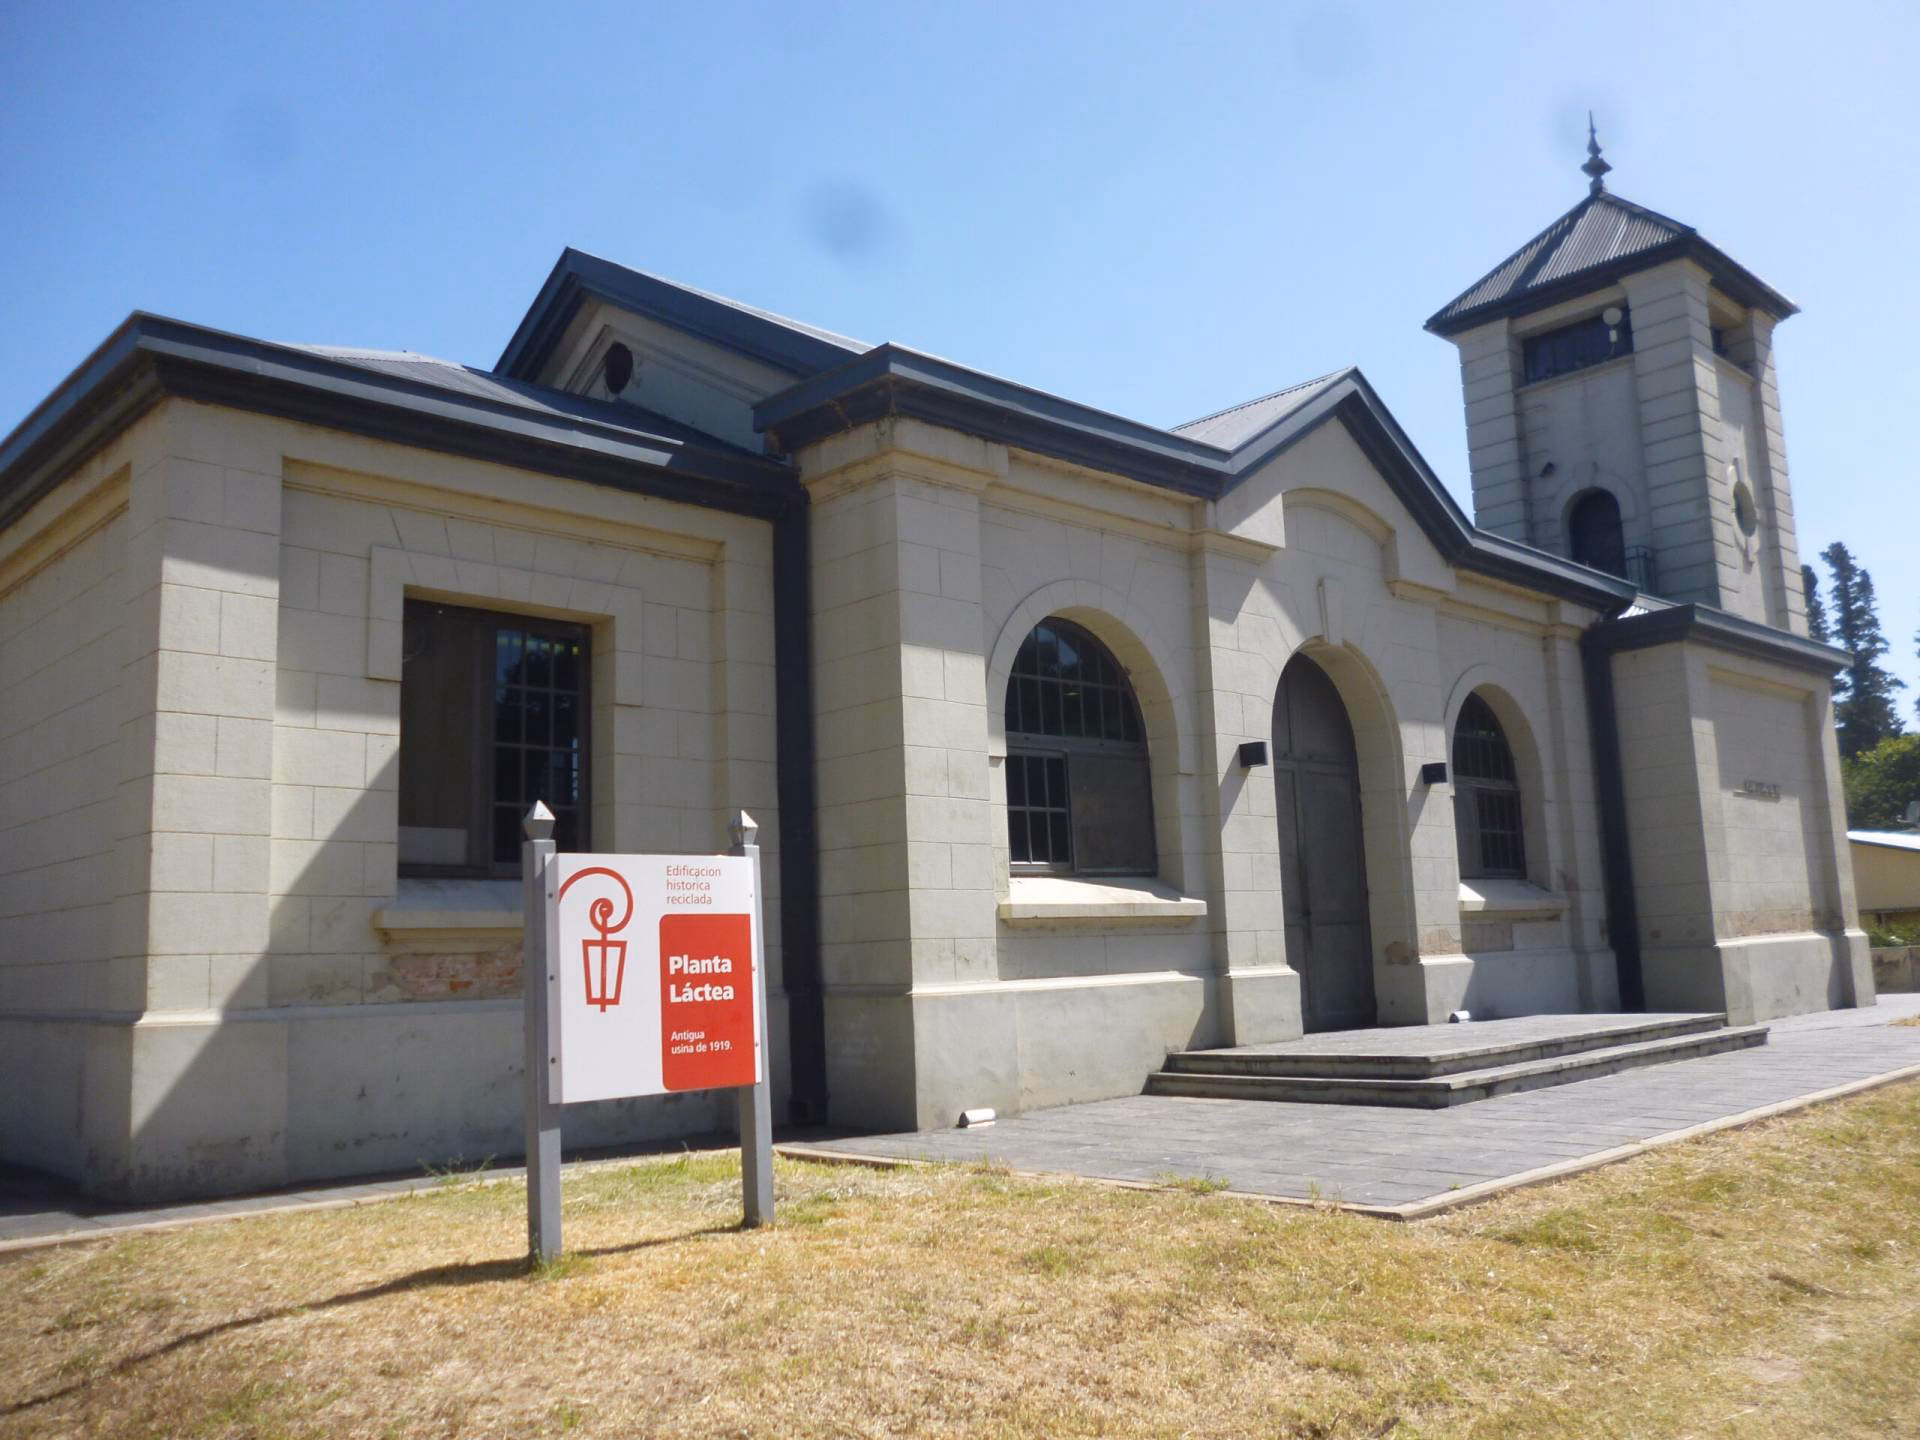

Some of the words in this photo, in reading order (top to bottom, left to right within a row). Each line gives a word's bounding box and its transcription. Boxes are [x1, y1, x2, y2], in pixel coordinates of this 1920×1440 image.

[666, 894, 712, 905] reciclada
[669, 954, 732, 975] Planta
[670, 982, 734, 1003] Láctea
[671, 1030, 705, 1043] Antigua
[671, 1045, 694, 1054] usina
[696, 1043, 707, 1052] de
[709, 1041, 733, 1051] 1919.
